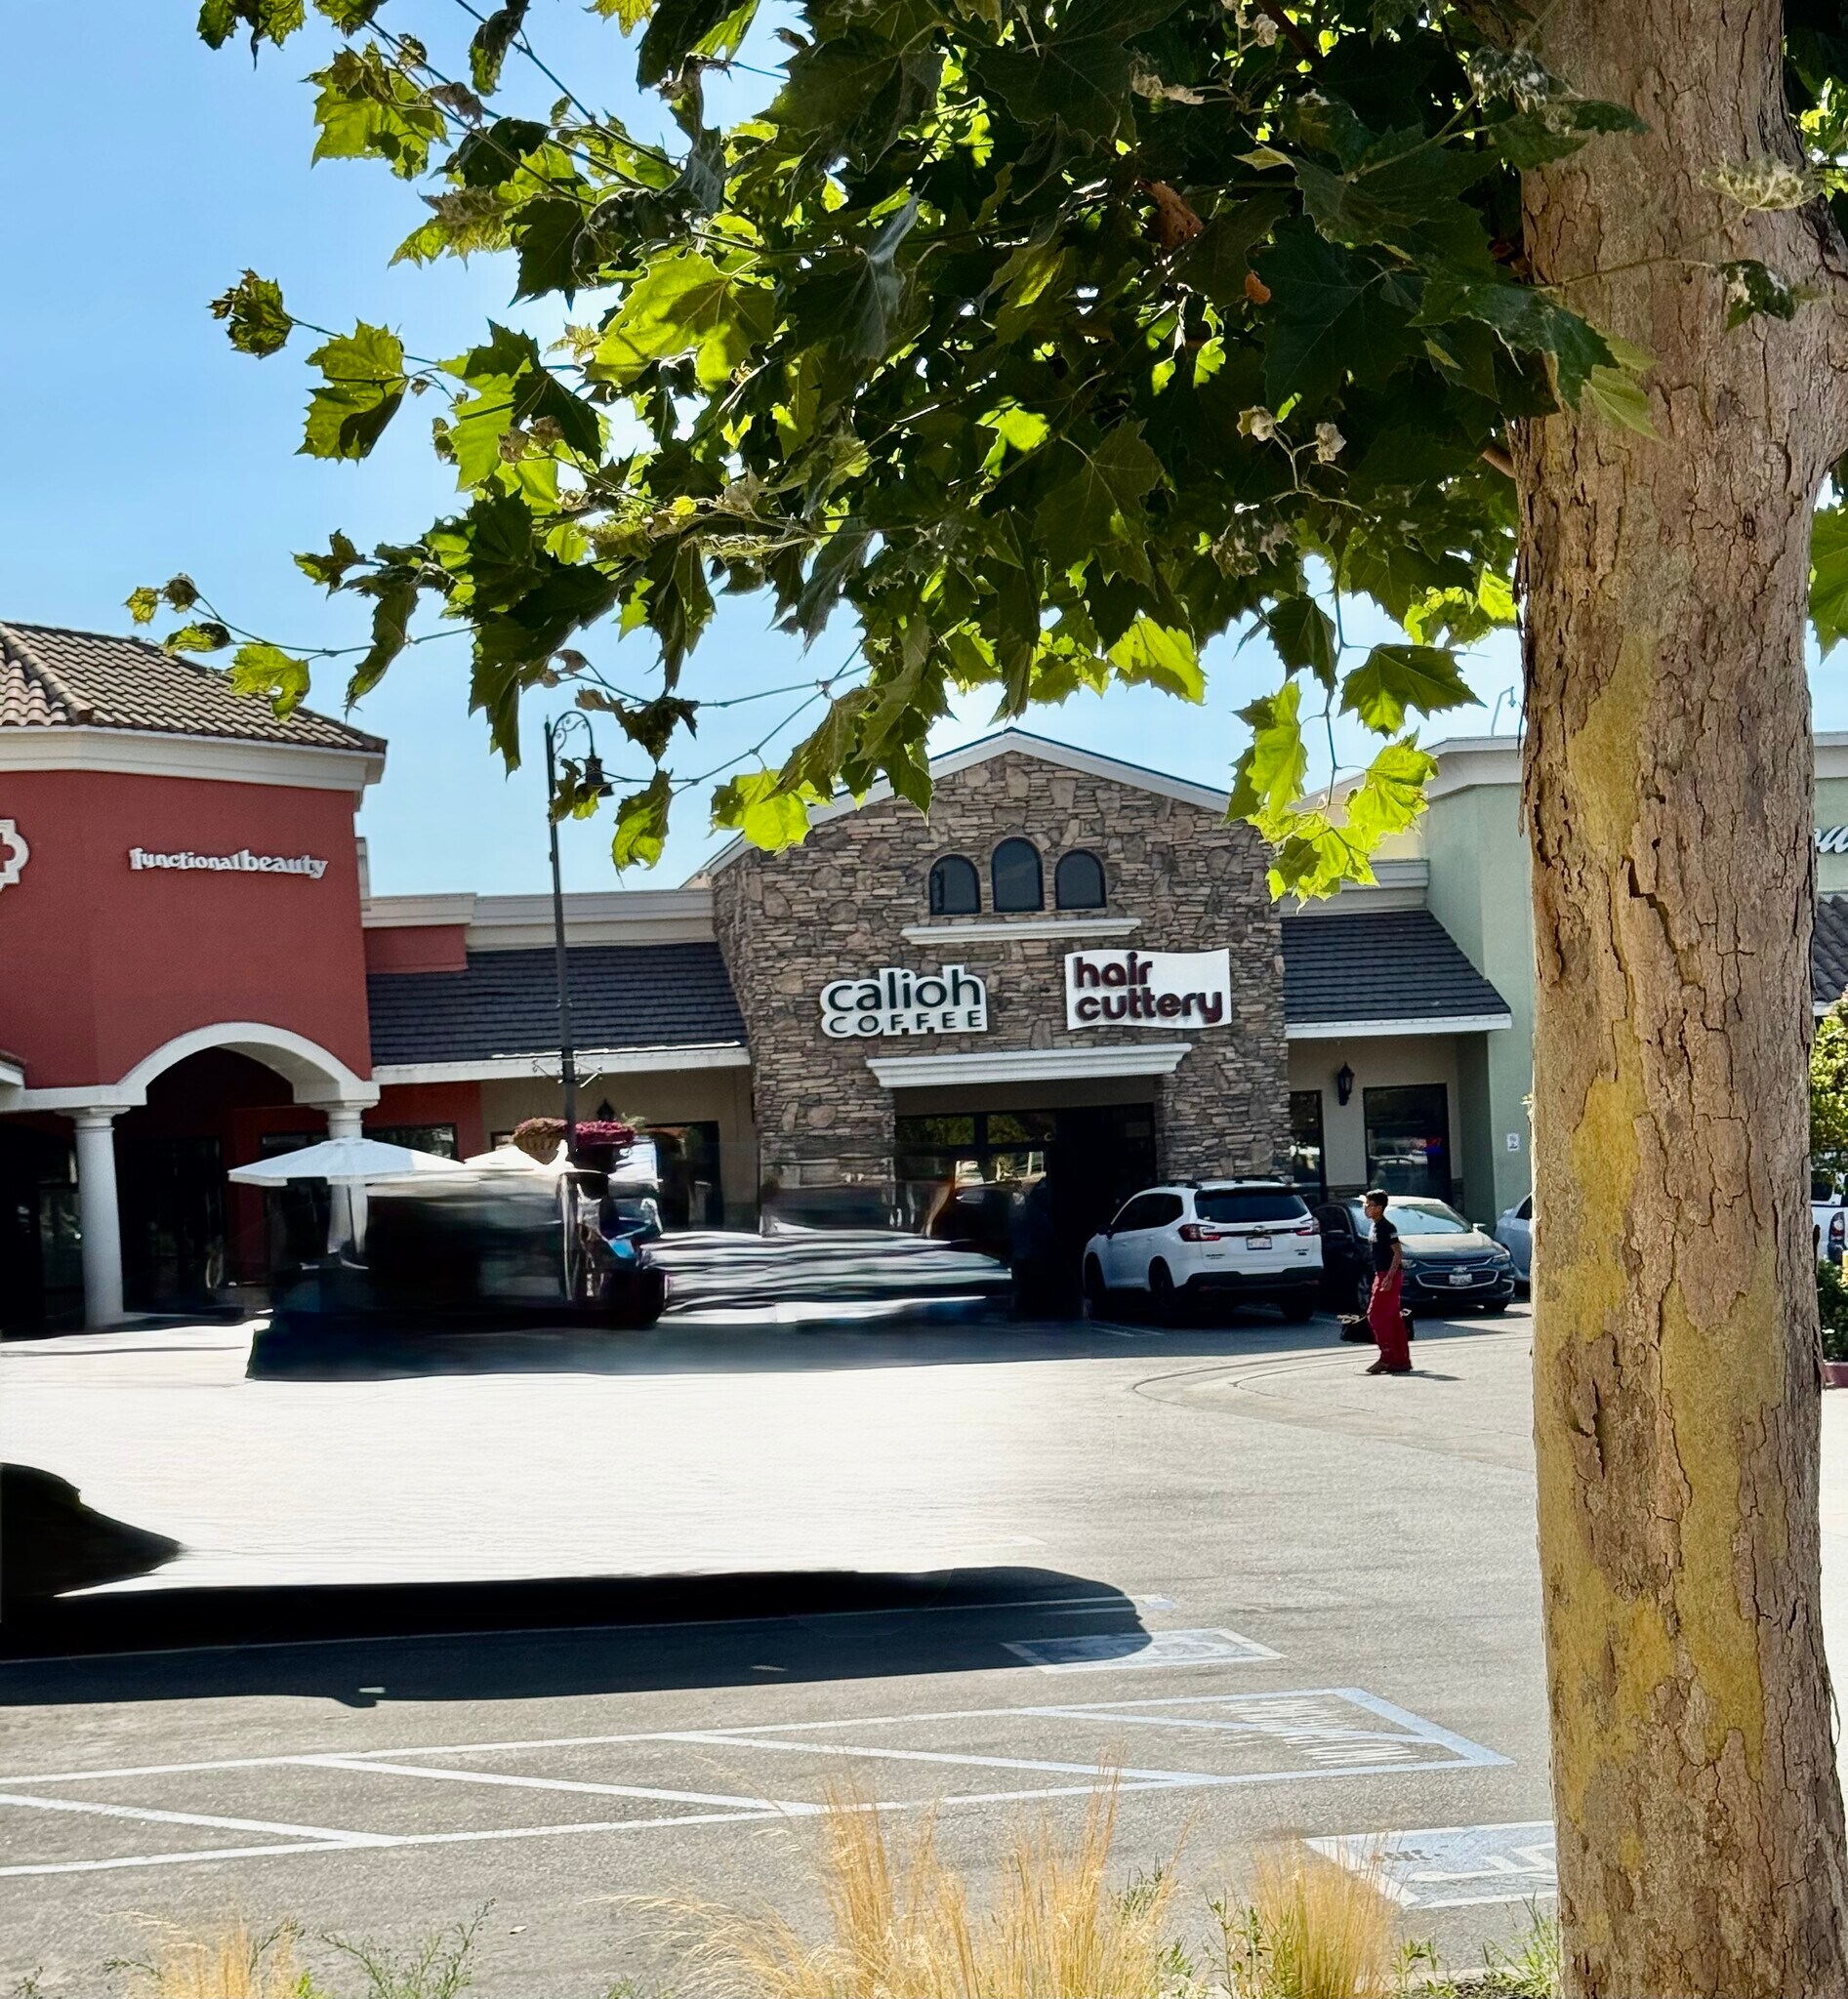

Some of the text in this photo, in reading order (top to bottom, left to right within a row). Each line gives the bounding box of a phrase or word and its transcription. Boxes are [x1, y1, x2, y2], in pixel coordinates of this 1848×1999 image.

[828, 965, 981, 1011] calioh
[1075, 952, 1153, 988] hair
[829, 1010, 983, 1035] COFFEE
[1076, 987, 1224, 1024] cuttery
